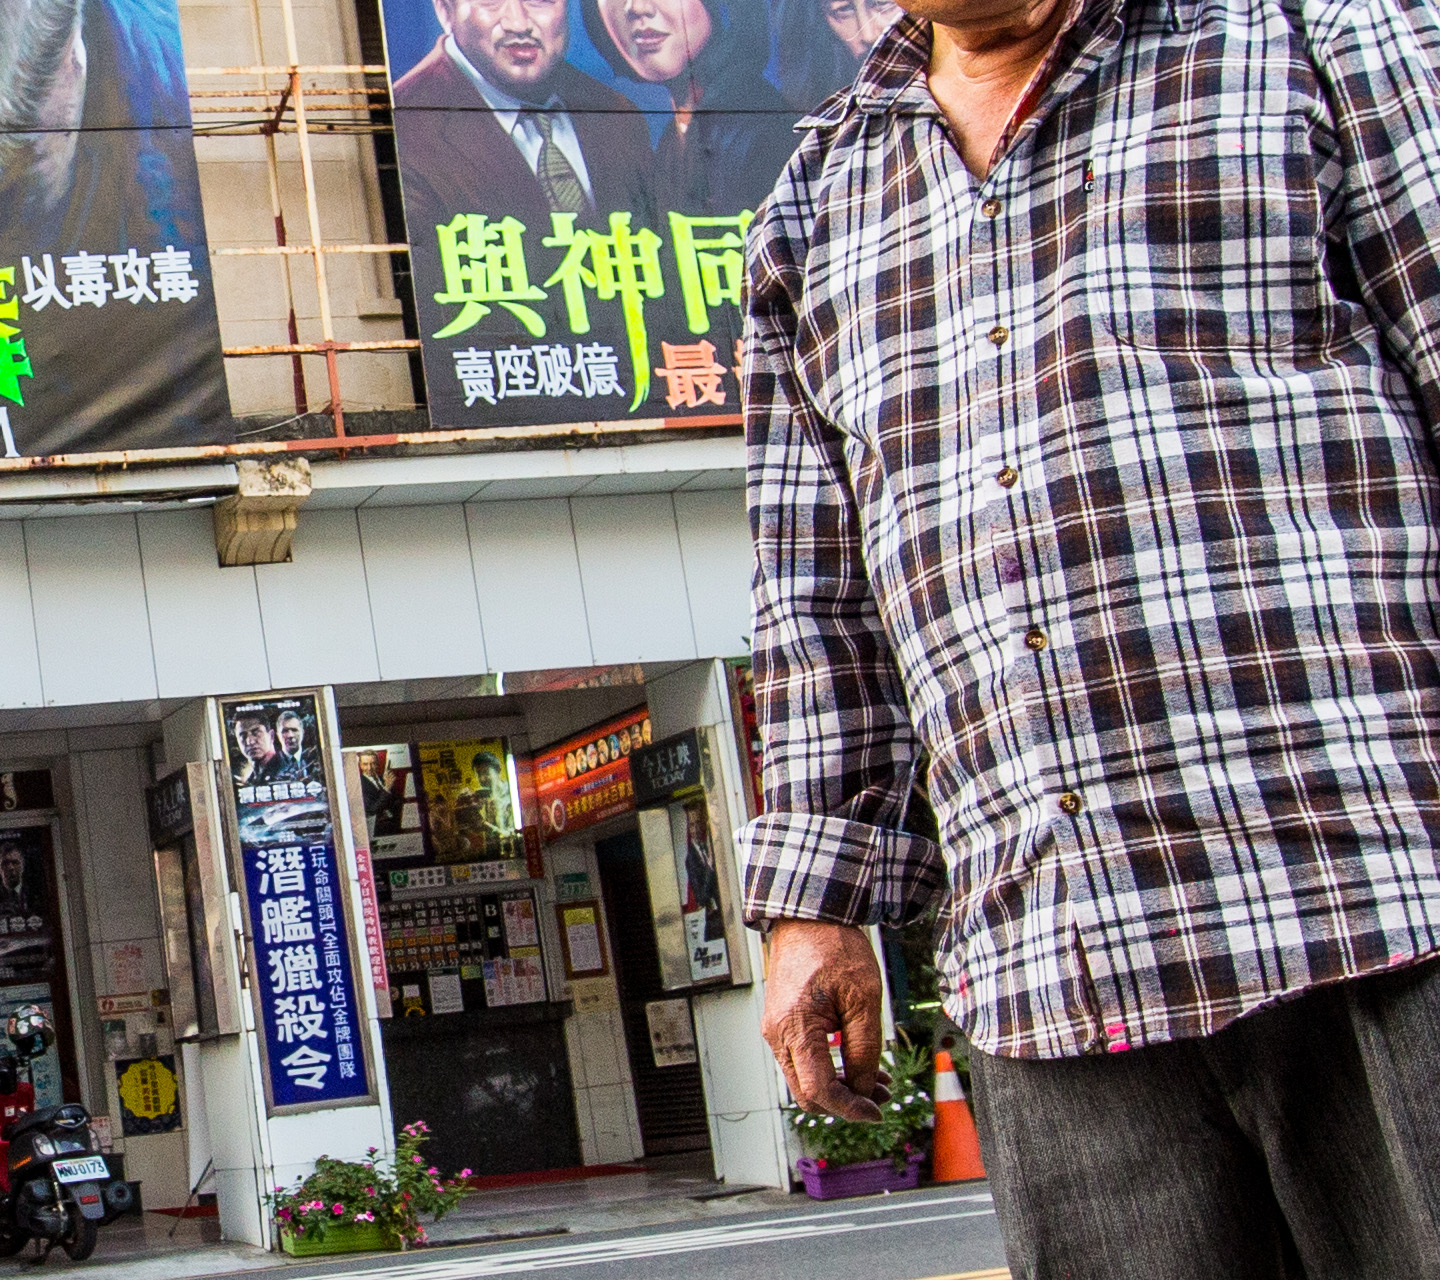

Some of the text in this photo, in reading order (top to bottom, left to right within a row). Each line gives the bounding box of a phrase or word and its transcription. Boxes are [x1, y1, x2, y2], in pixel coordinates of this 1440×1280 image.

[21, 245, 200, 311] 以毒攻毒
[452, 341, 626, 408] 賣座破億
[655, 338, 747, 411] 最
[254, 845, 333, 1091] 潛艦獵殺令
